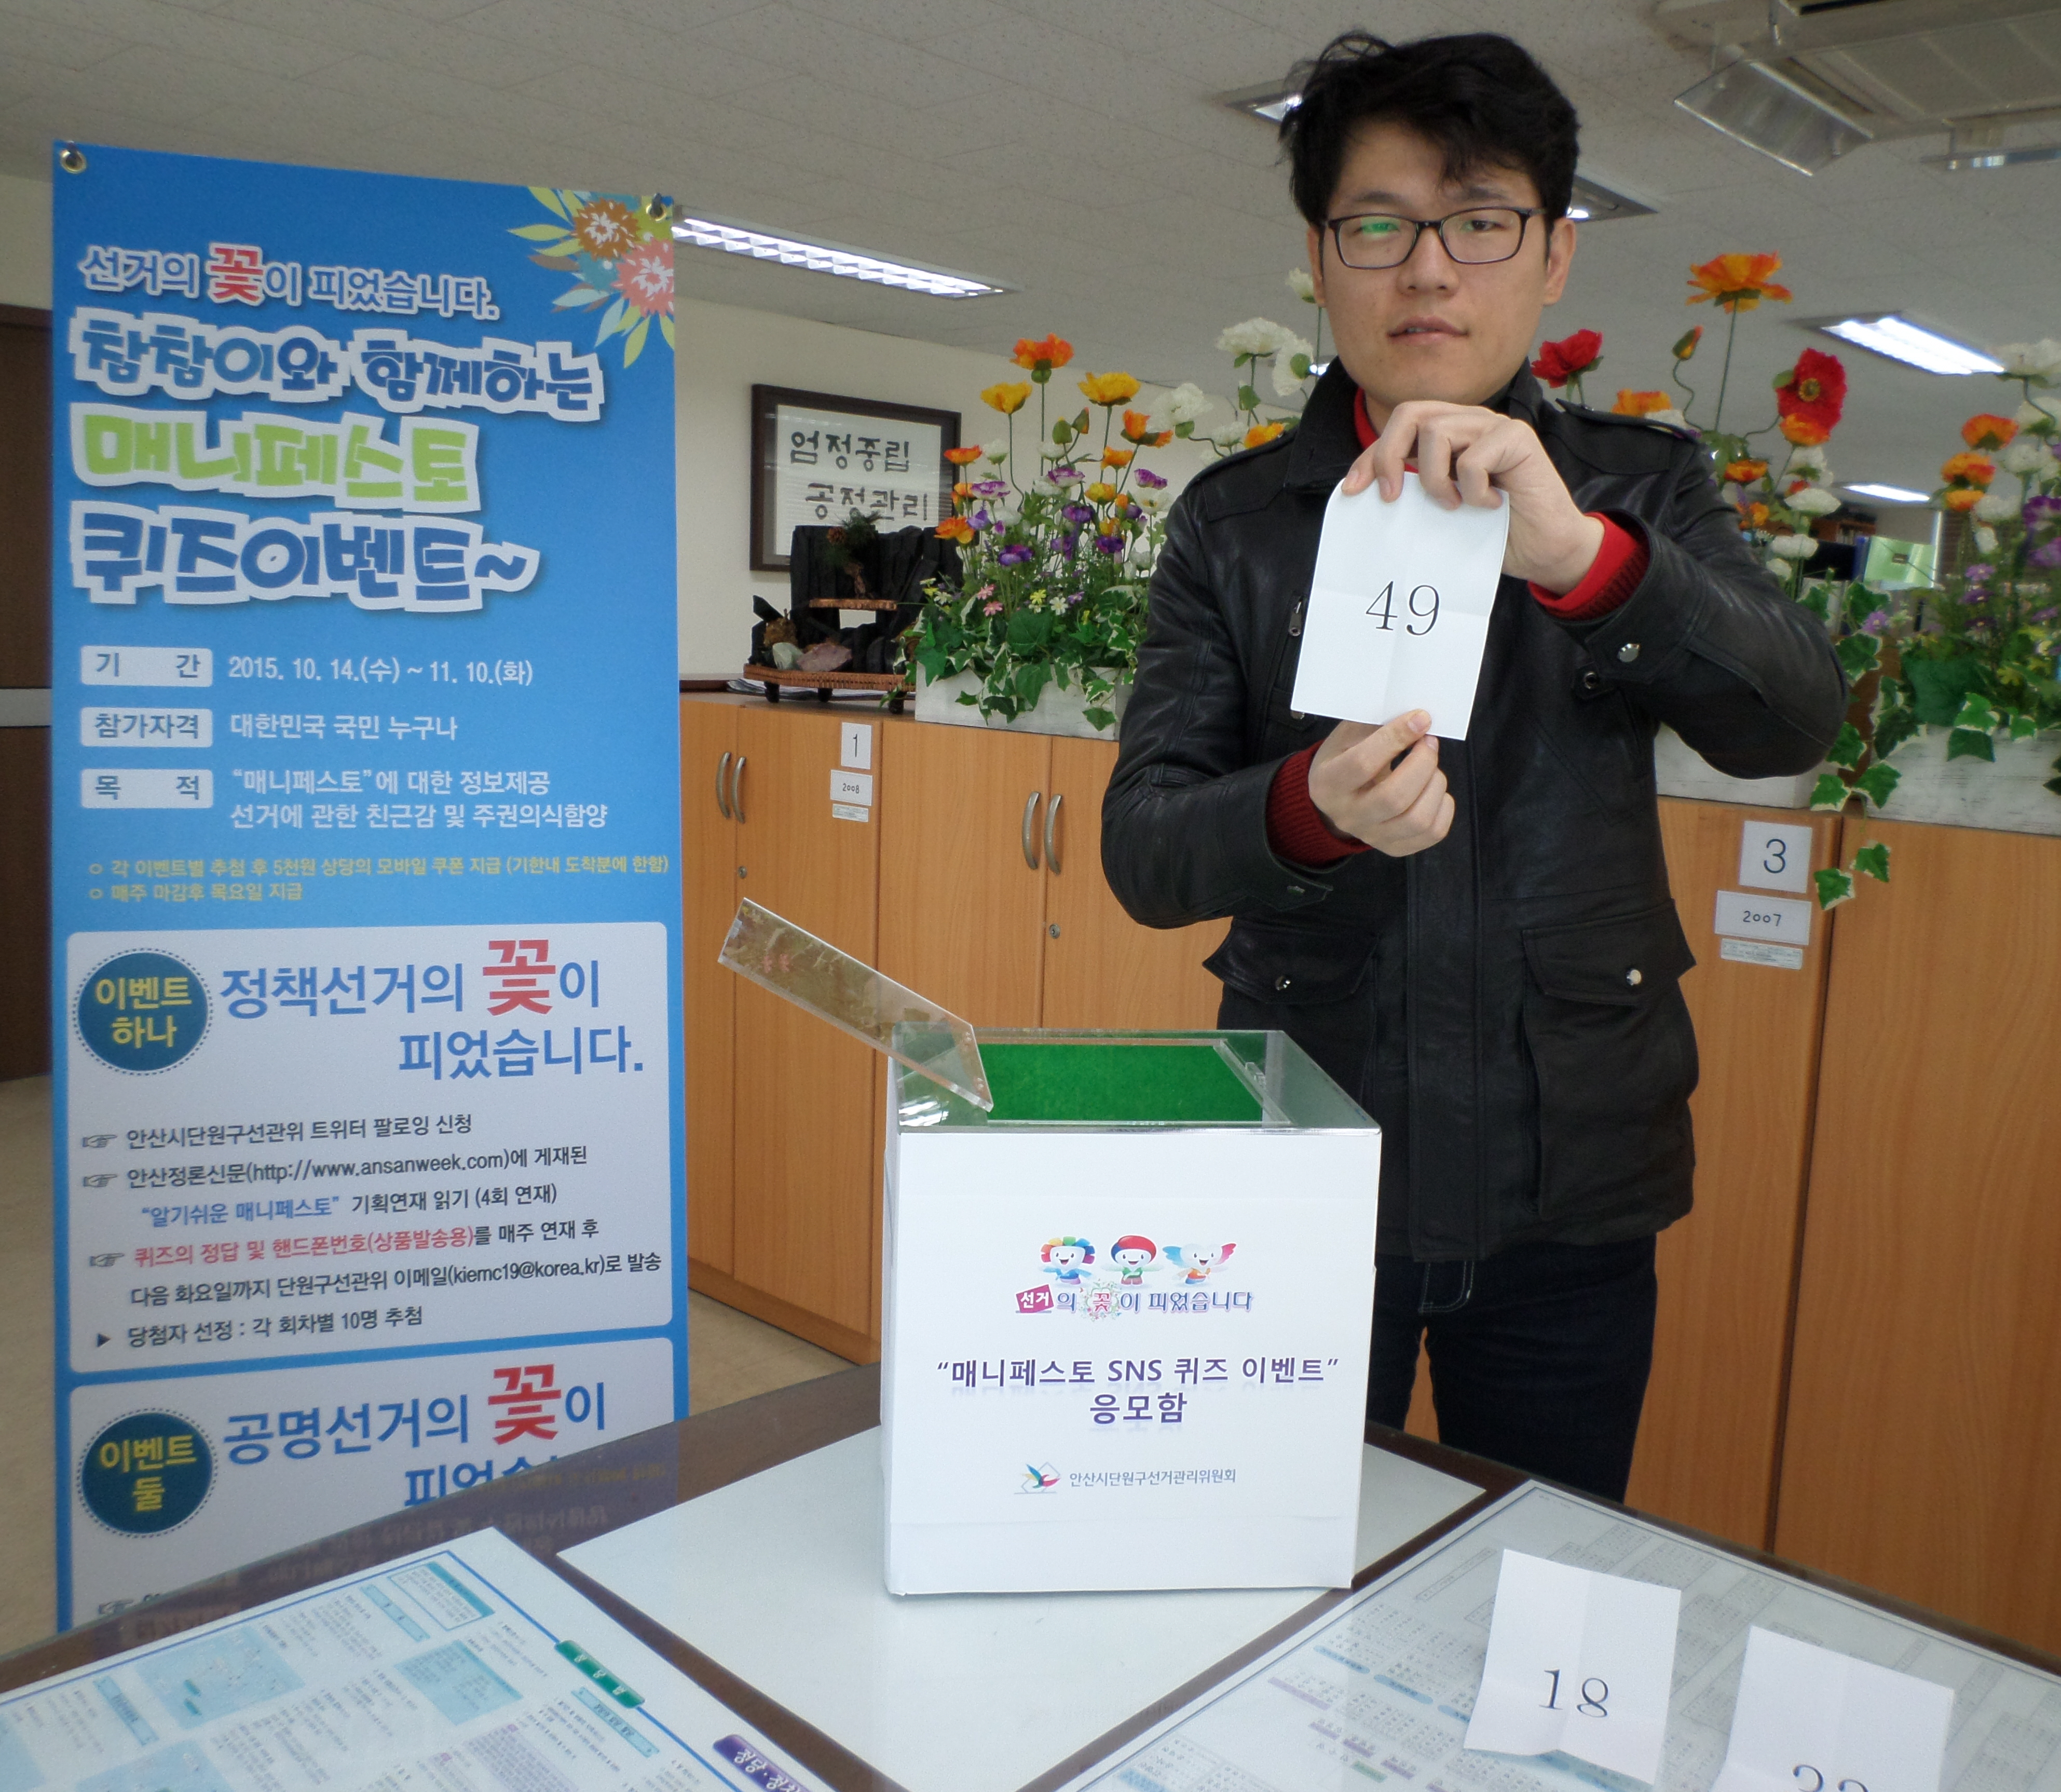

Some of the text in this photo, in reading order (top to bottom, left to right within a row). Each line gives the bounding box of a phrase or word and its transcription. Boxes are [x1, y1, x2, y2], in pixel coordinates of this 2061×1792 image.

[86, 246, 499, 319] 선거의 꽃이 피었습니다.
[83, 319, 593, 411] 참참이와 함께하는
[84, 414, 468, 502] 매니페스토
[790, 430, 910, 472] 엄정중립
[805, 482, 928, 521] 공정관리
[84, 512, 528, 601] 퀴즈이벤트~
[1365, 580, 1440, 636] 49
[228, 656, 284, 680] 2015.
[293, 657, 321, 681] 10.
[331, 656, 400, 684] 14.(수)
[430, 661, 458, 683] 11.
[466, 659, 534, 686] 10.(화)
[94, 713, 200, 739] 참가자격
[230, 713, 458, 740] 대한민국 국민 누구나
[853, 734, 857, 757] 1
[407, 771, 453, 795] 대한
[460, 771, 550, 795] 정보제공
[842, 783, 860, 794] 2008
[230, 804, 608, 829] 선거에 관한 친근감 및 주권의식함양
[111, 855, 670, 878] 각 이벤트별 추첨 후 5천원 상당의 모바일 쿠폰 지급 (기한내 도착분에 한함)
[1764, 838, 1786, 874] 3
[111, 883, 304, 903] 매주 마감후 목요일 지급
[1742, 911, 1781, 926] 2007
[95, 975, 192, 1011] 이벤트
[220, 939, 600, 1020] 정책선거의 꽃이
[112, 1015, 179, 1050] 하나
[399, 1026, 644, 1080] 피었습니다.
[126, 1114, 472, 1149] 안산시단원구선관위 트위터 팔로잉 신청
[534, 1145, 588, 1166] 게재된
[352, 1191, 427, 1215] 기획연재
[433, 1189, 469, 1210] 읽기
[475, 1187, 509, 1209] (4회
[514, 1183, 557, 1204] 연재)
[134, 1245, 194, 1268] 퀴즈의
[201, 1242, 238, 1264] 정답
[247, 1240, 265, 1260] 및
[498, 1223, 535, 1243] 매주
[540, 1220, 576, 1241] 연재
[581, 1219, 599, 1238] 후
[130, 1286, 169, 1307] 다음
[174, 1279, 271, 1304] 화요일까지
[277, 1271, 388, 1297] 단원구선관위
[627, 1252, 662, 1273] 발송
[1019, 1291, 1253, 1313] 선거의 꽃이 피었습니다
[127, 1324, 187, 1348] 당첨자
[194, 1321, 234, 1344] 선정
[252, 1319, 271, 1338] 각
[278, 1312, 335, 1335] 회차별
[341, 1309, 377, 1331] 10명
[385, 1306, 424, 1327] 추첨
[1108, 1359, 1164, 1383] SNS
[1173, 1358, 1229, 1385] 퀴즈
[223, 1363, 606, 1465] 공명선거의 꽃이
[1089, 1393, 1188, 1425] 응모함
[99, 1434, 198, 1473] 이벤트
[132, 1477, 166, 1512] 둘
[1069, 1468, 1237, 1488] 안산시단원구선거관리위원회
[1538, 1668, 1609, 1718] 18
